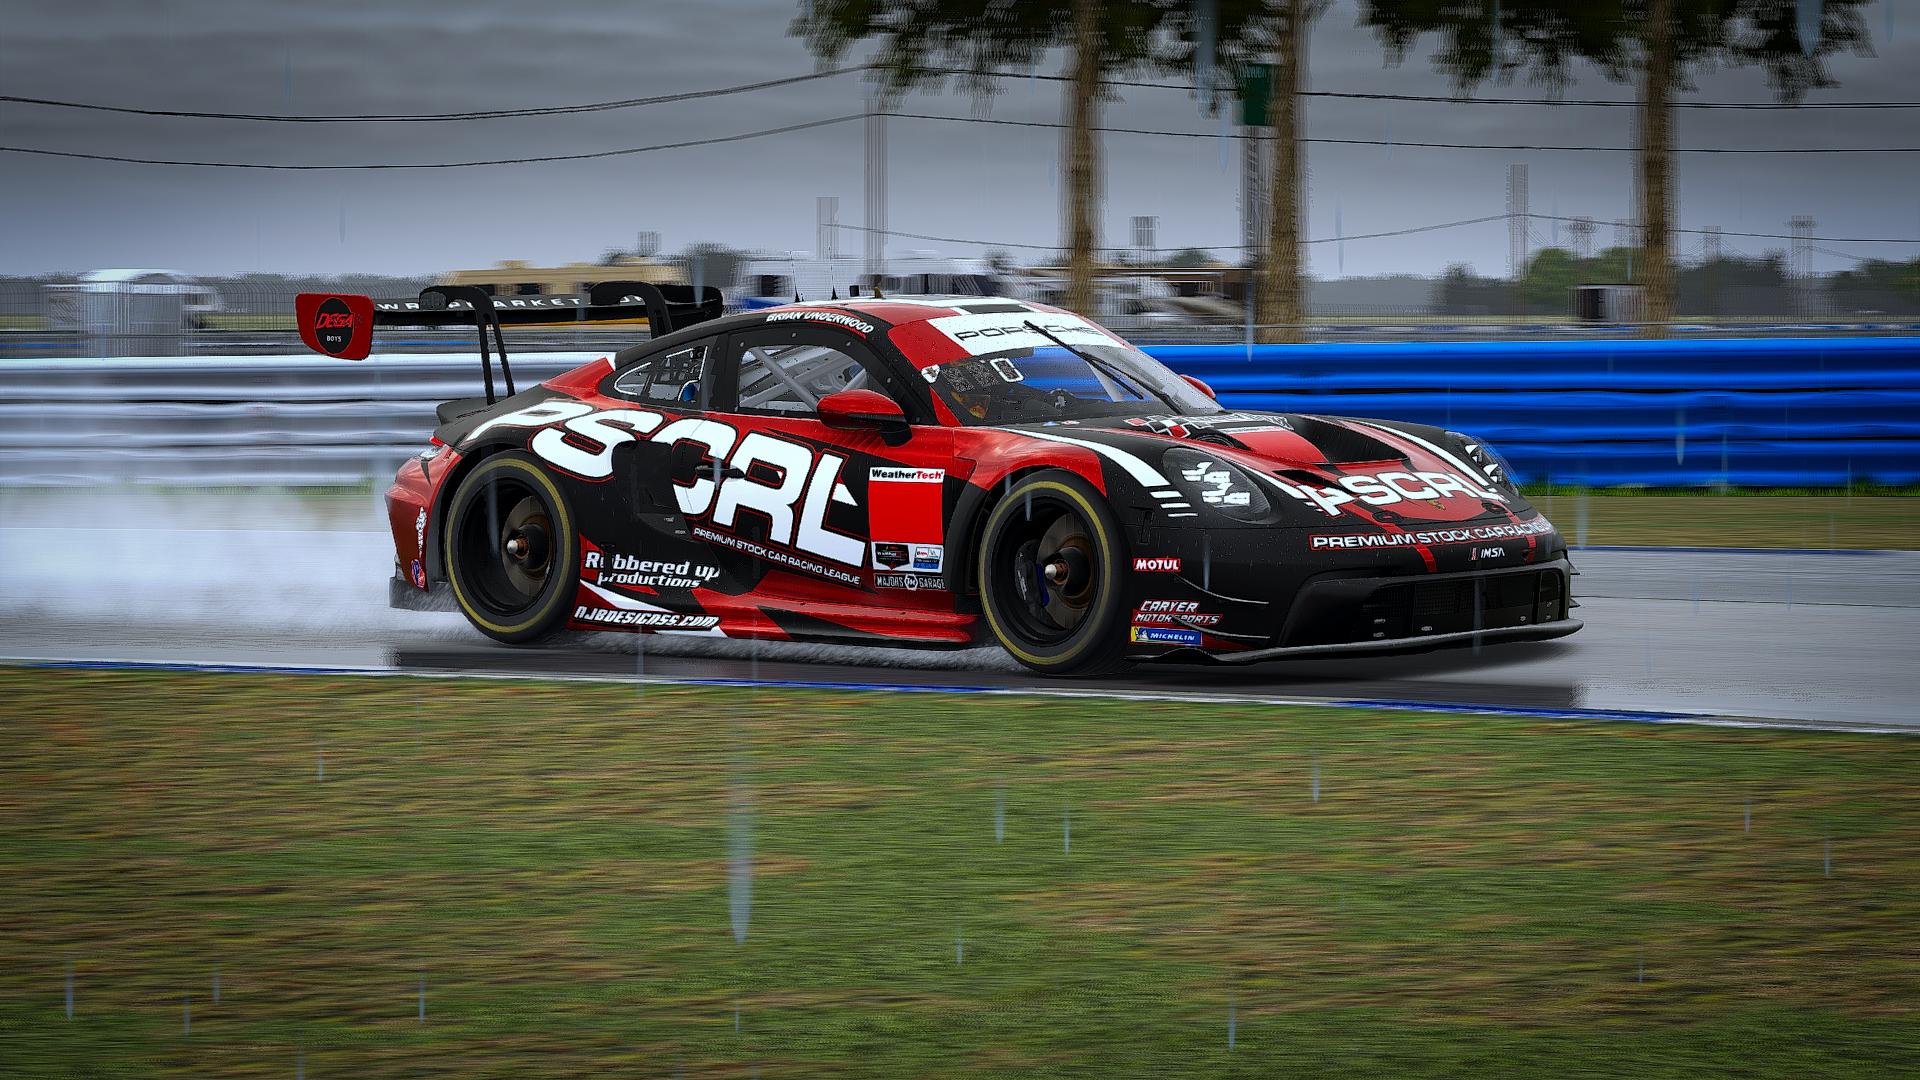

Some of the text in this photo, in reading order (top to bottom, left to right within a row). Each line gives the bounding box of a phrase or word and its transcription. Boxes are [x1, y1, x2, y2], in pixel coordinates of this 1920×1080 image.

[766, 312, 875, 334] BRIAN UNDERWOOD
[872, 469, 942, 480] WeatherTech
[466, 401, 867, 567] PSCRL
[1297, 472, 1510, 516] PSCRL
[1313, 534, 1416, 549] PREMIUM
[1418, 529, 1474, 545] STOCK
[1474, 527, 1507, 539] CAR
[693, 527, 861, 585] PREMIUM STOCK CAR RACING LEAGUE
[1480, 547, 1505, 559] IMSA
[1135, 559, 1179, 570] MOTUL
[597, 571, 701, 588] productions
[694, 565, 721, 581] up
[918, 577, 946, 589] GARAGE
[1149, 633, 1196, 641] MICHELIN
